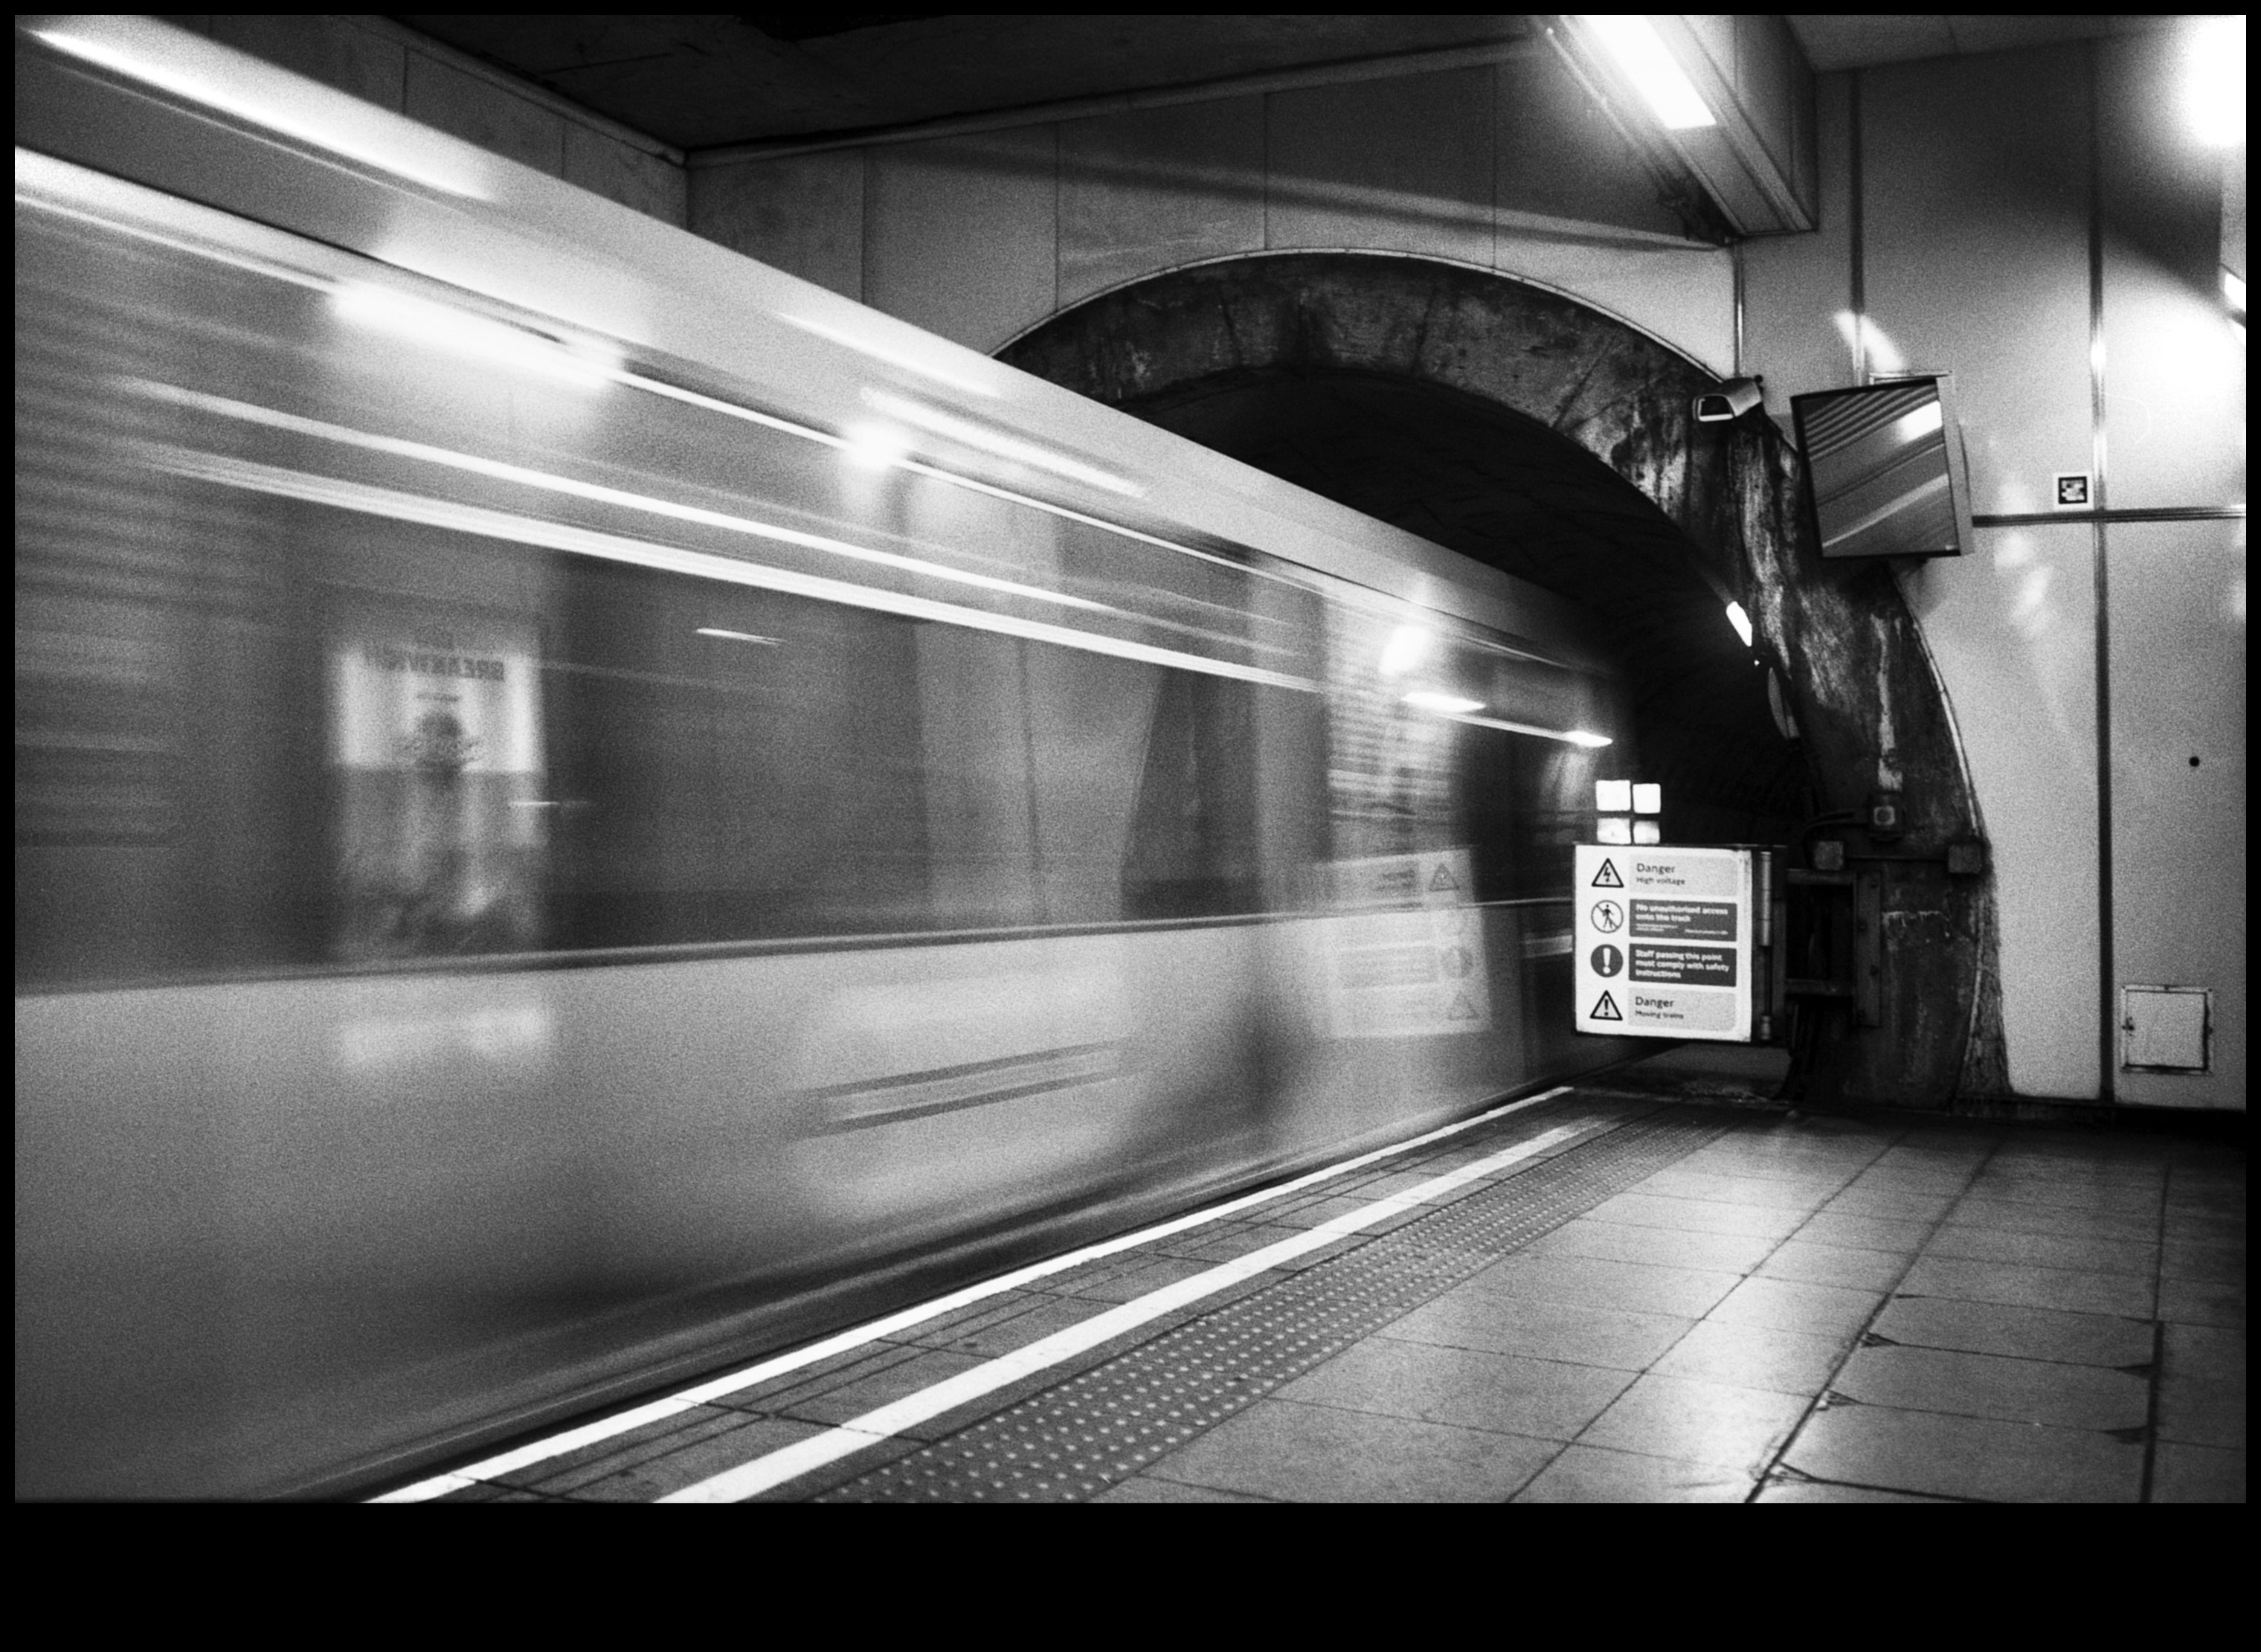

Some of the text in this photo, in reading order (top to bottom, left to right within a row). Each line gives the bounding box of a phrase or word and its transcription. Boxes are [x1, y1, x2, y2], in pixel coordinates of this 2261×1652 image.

[1636, 863, 1676, 875] Danger
[1636, 903, 1648, 911] No
[1636, 949, 1655, 957] Staff
[1656, 952, 1685, 960] passing
[1656, 961, 1685, 970] comply
[1686, 962, 1704, 970] with
[1705, 962, 1730, 972] safety
[1636, 968, 1682, 978] instructions
[1635, 996, 1675, 1009] Danger
